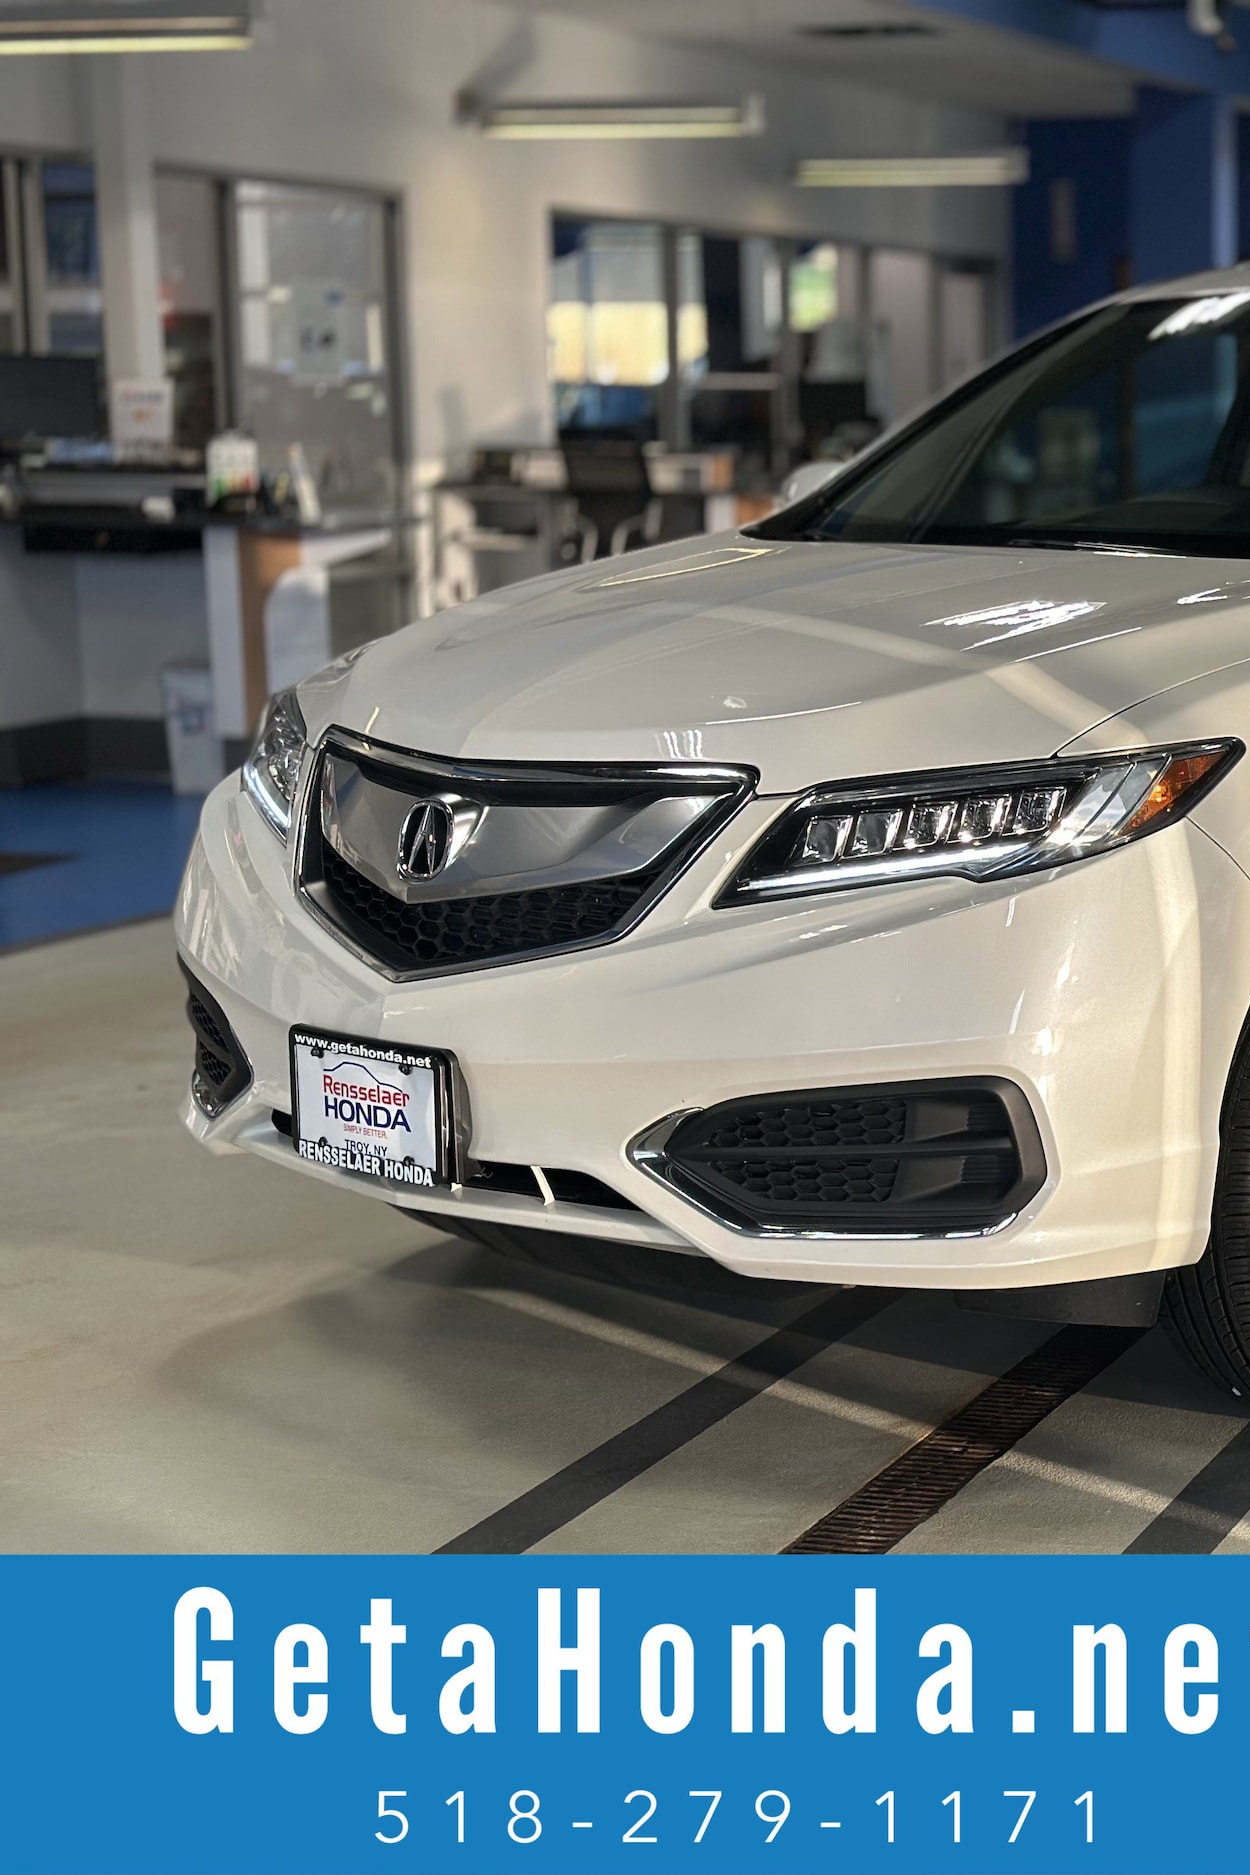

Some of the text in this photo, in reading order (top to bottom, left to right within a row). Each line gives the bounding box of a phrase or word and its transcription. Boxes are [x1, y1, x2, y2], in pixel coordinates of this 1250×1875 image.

[294, 1033, 432, 1069] www.getahonda.net
[323, 1074, 410, 1107] Rensselaer
[324, 1095, 412, 1133] HONDA
[343, 1123, 362, 1136] SIMPLY
[299, 1139, 434, 1187] RENSSELAER HONDA
[374, 1146, 388, 1157] NY
